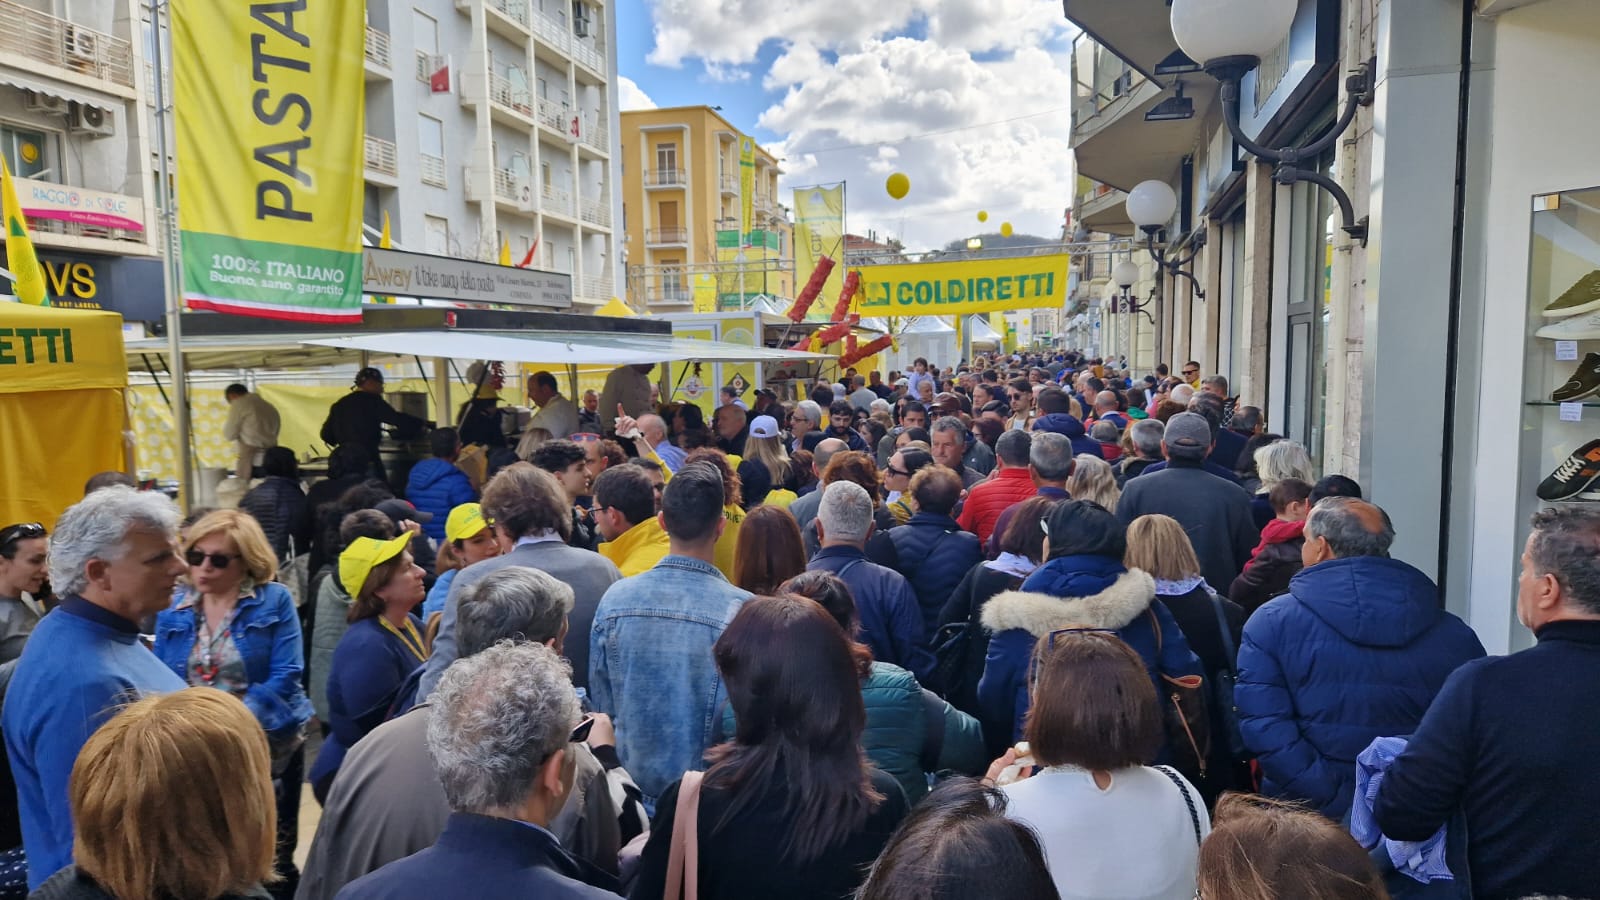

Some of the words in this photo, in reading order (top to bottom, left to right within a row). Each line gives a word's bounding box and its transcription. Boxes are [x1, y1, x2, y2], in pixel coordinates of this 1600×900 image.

[250, 0, 313, 222] PASTA
[32, 187, 80, 206] RAGGIO
[211, 253, 261, 275] 100%
[267, 261, 345, 283] ITALIANO
[363, 251, 412, 291] Away
[421, 266, 440, 289] take
[440, 272, 459, 294] away
[477, 274, 496, 295] pasta
[297, 282, 345, 296] garantito
[896, 271, 1055, 306] COLDIRETTI
